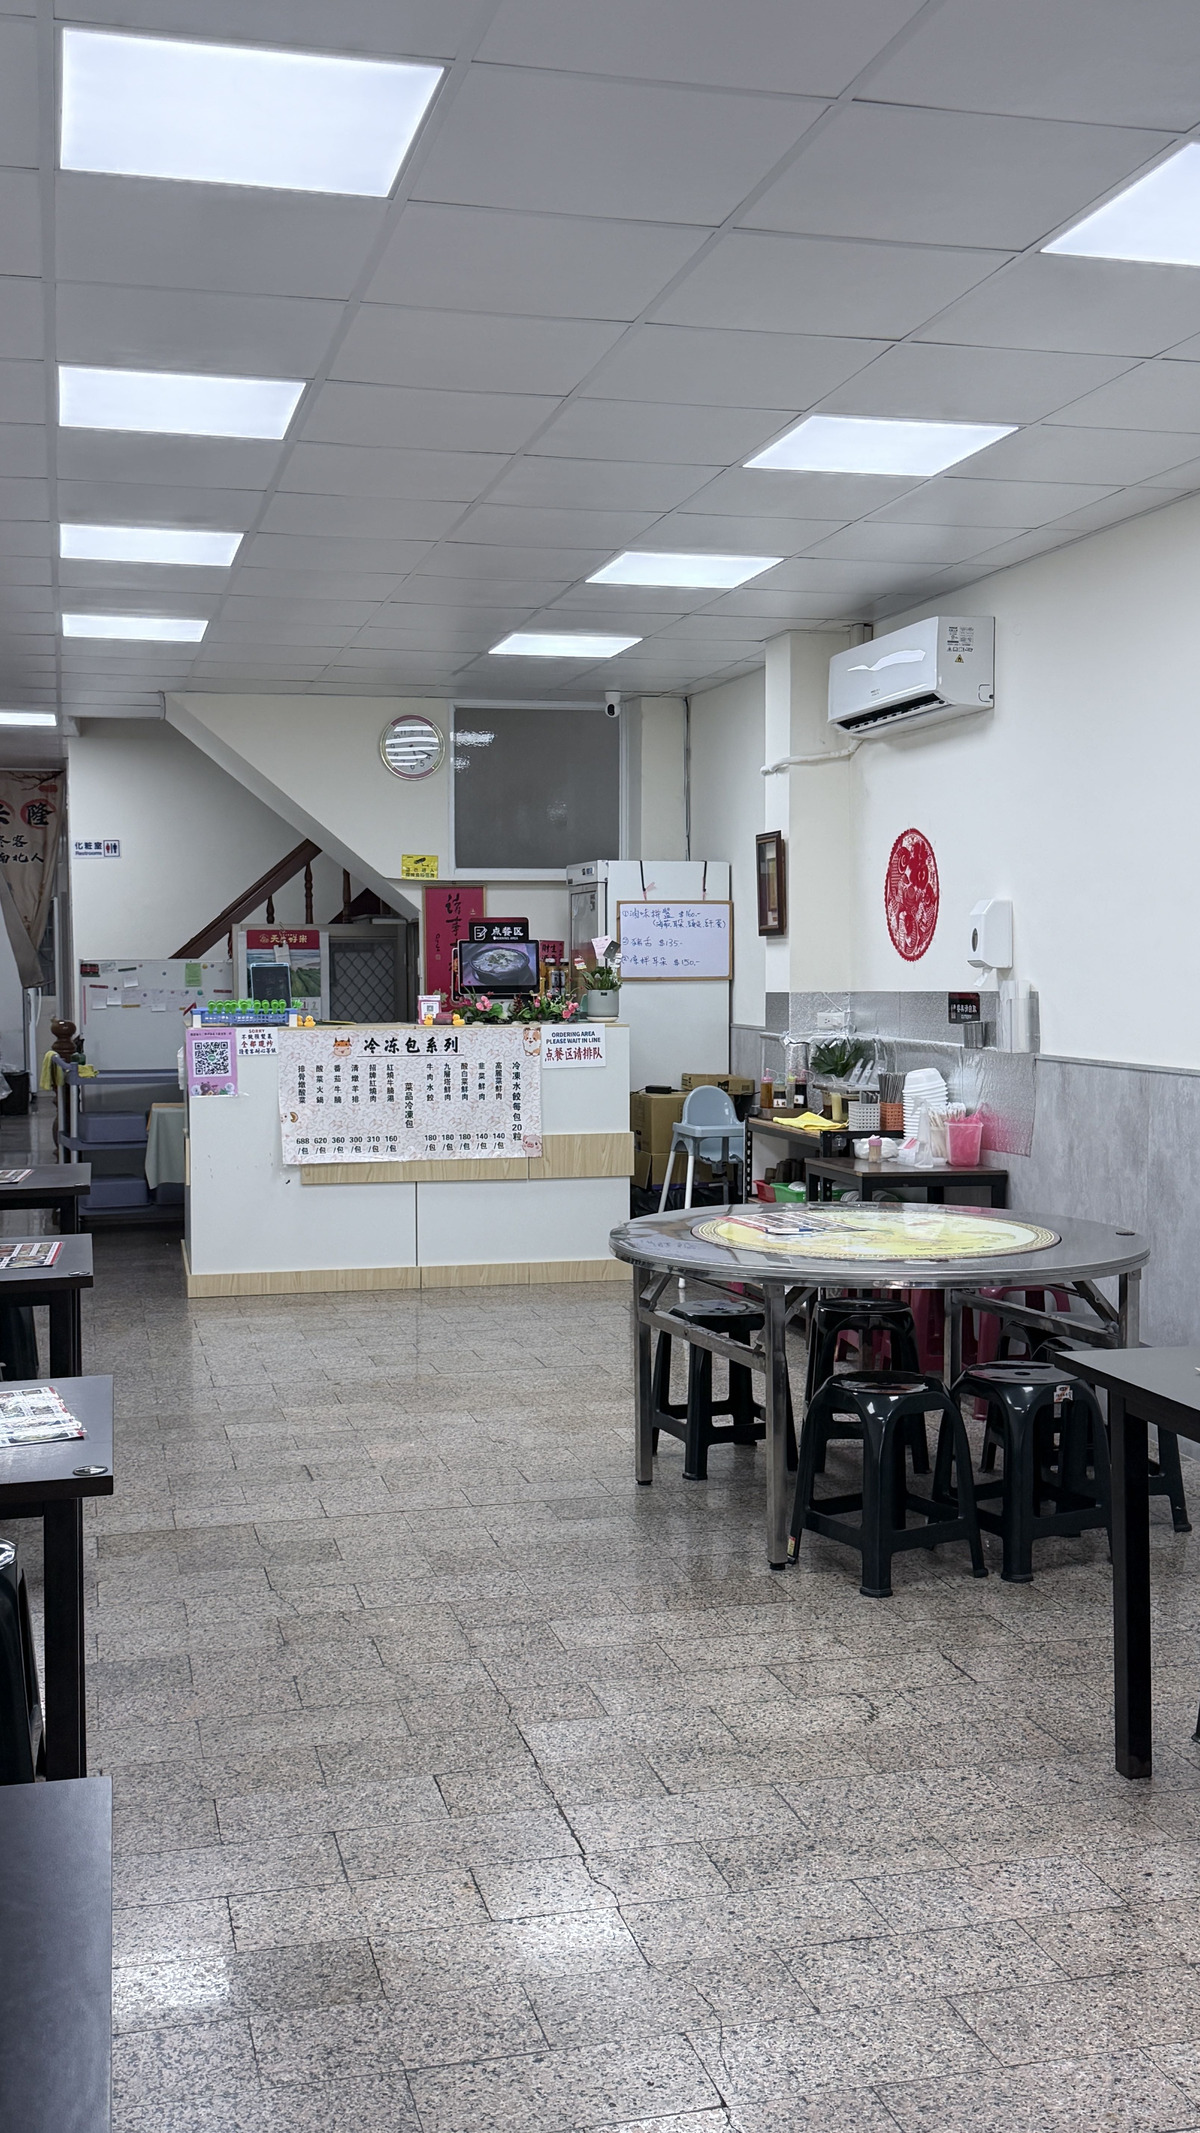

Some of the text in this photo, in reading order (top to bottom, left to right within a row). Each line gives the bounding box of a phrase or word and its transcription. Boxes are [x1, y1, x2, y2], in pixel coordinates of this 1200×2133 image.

[364, 1036, 459, 1054] 冷冻包系列
[544, 1047, 603, 1062] 点餐区请排队
[426, 1064, 434, 1102] 牛肉水餃
